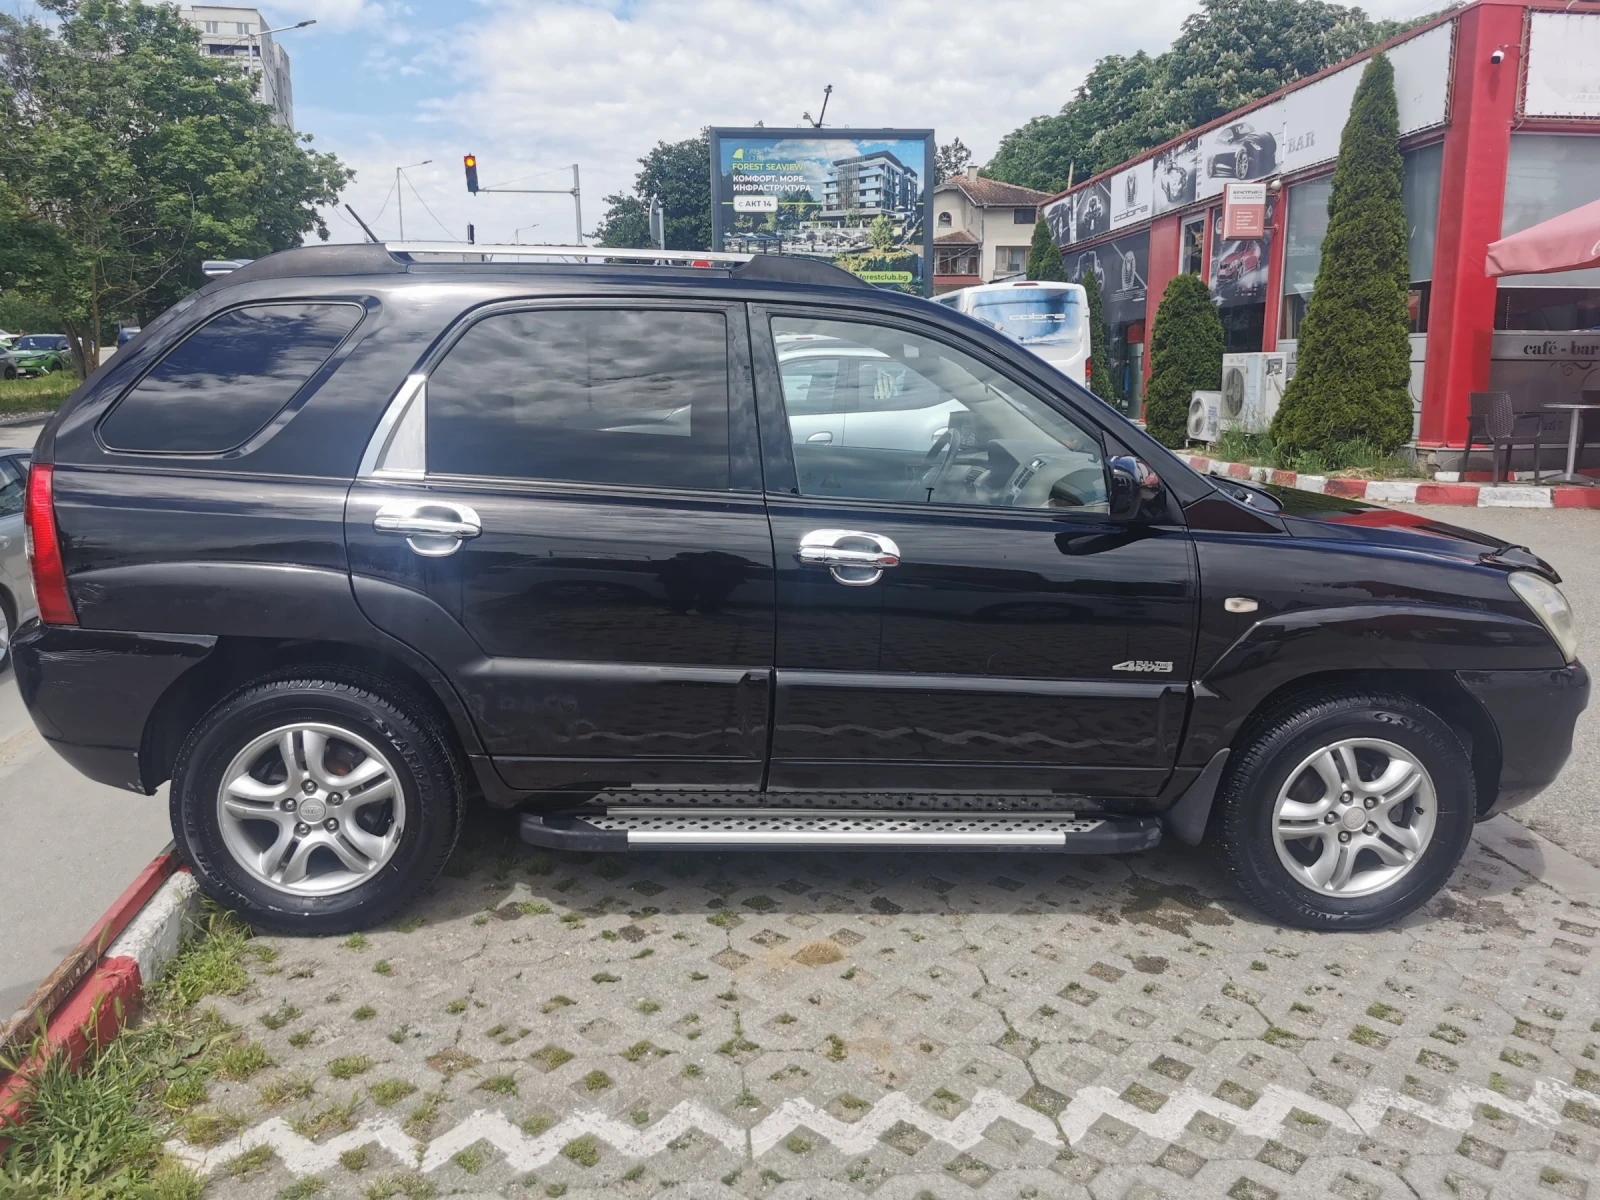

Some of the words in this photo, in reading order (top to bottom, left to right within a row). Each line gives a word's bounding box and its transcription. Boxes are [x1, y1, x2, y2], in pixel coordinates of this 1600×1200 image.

[1287, 130, 1316, 154] BAR
[732, 163, 764, 171] FOREST
[766, 163, 804, 171] SEAVIEW
[733, 184, 814, 192] ИНФРАСТРУКТУРА.
[1113, 204, 1148, 222] cobra
[860, 273, 908, 281] forestclub.bg
[1009, 312, 1066, 320] cobra
[1523, 340, 1557, 355] café
[1571, 340, 1600, 355] bar
